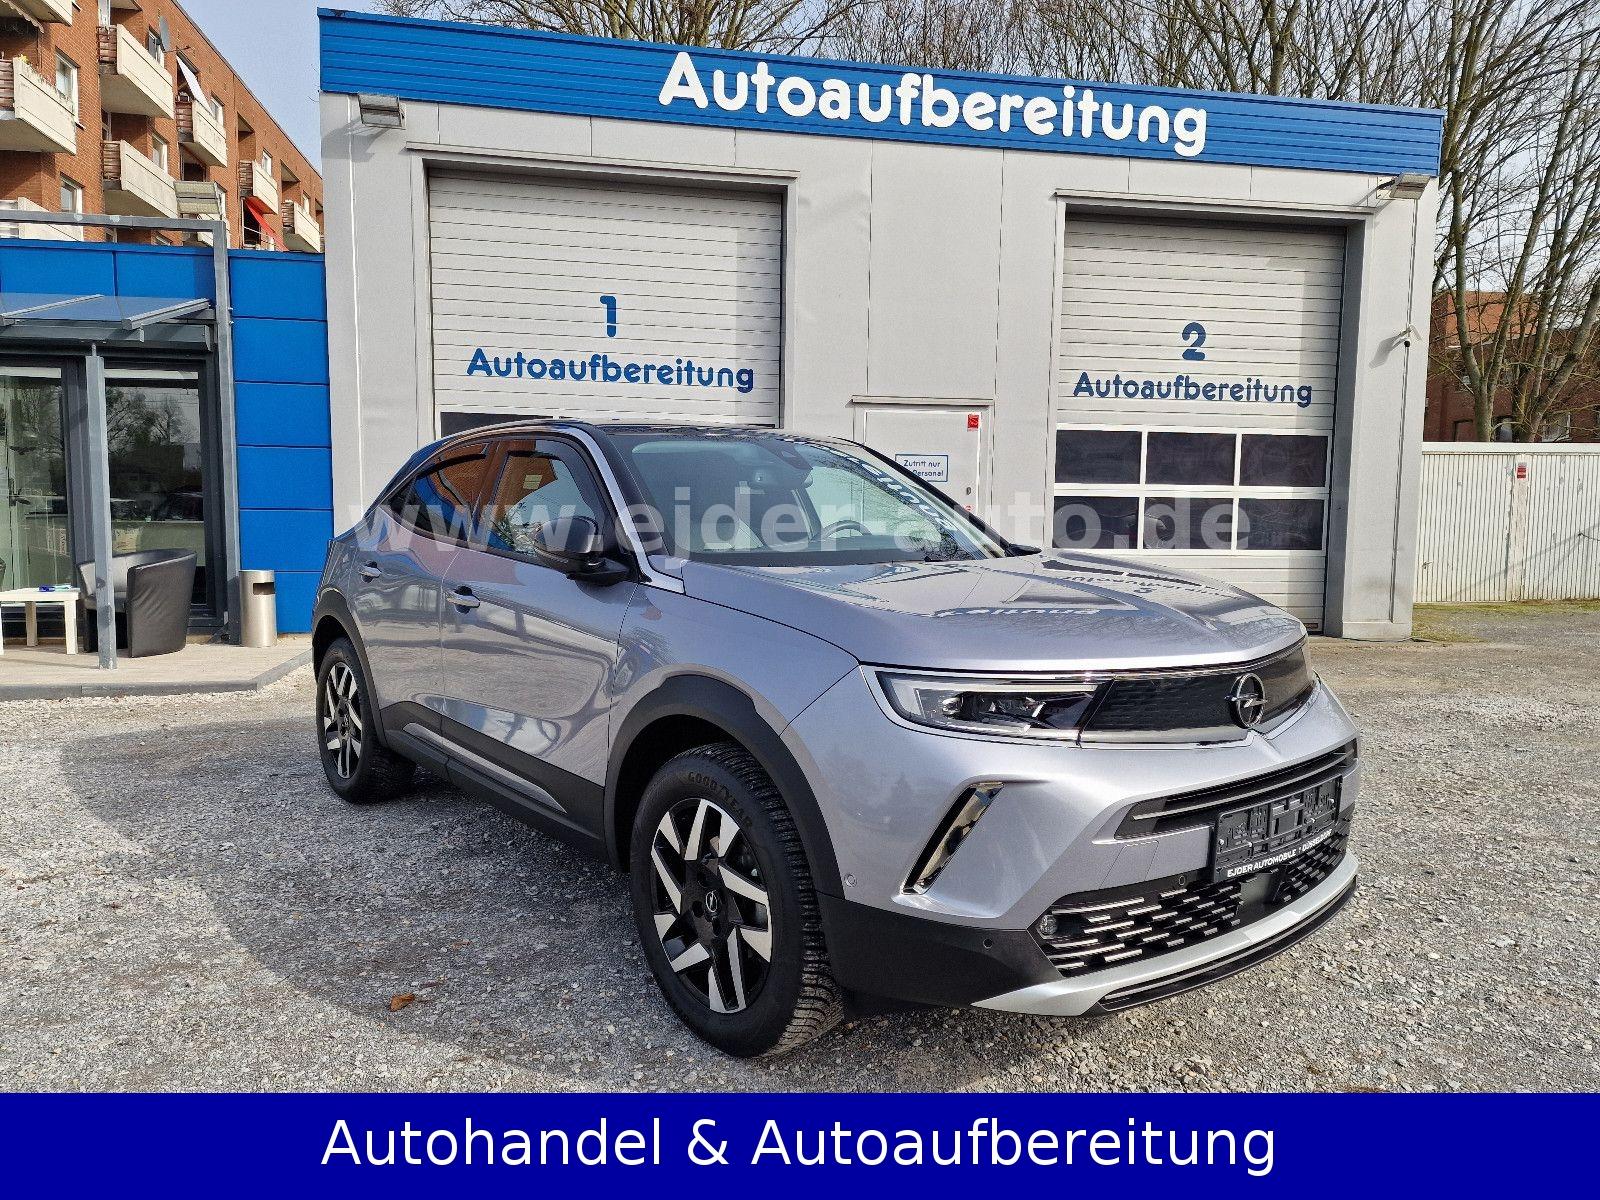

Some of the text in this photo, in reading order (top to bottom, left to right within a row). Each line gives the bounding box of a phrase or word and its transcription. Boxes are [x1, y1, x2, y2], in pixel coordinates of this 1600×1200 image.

[658, 51, 1208, 157] Autoaufbereitung
[600, 295, 617, 338] 1
[1181, 322, 1207, 361] 2
[466, 348, 754, 393] Autoaufbereitung
[1073, 372, 1313, 408] Autoaufbereitung
[912, 469, 944, 477] Personal
[1227, 863, 1253, 877] EJDER
[1253, 849, 1297, 870] AUTOMOBILE
